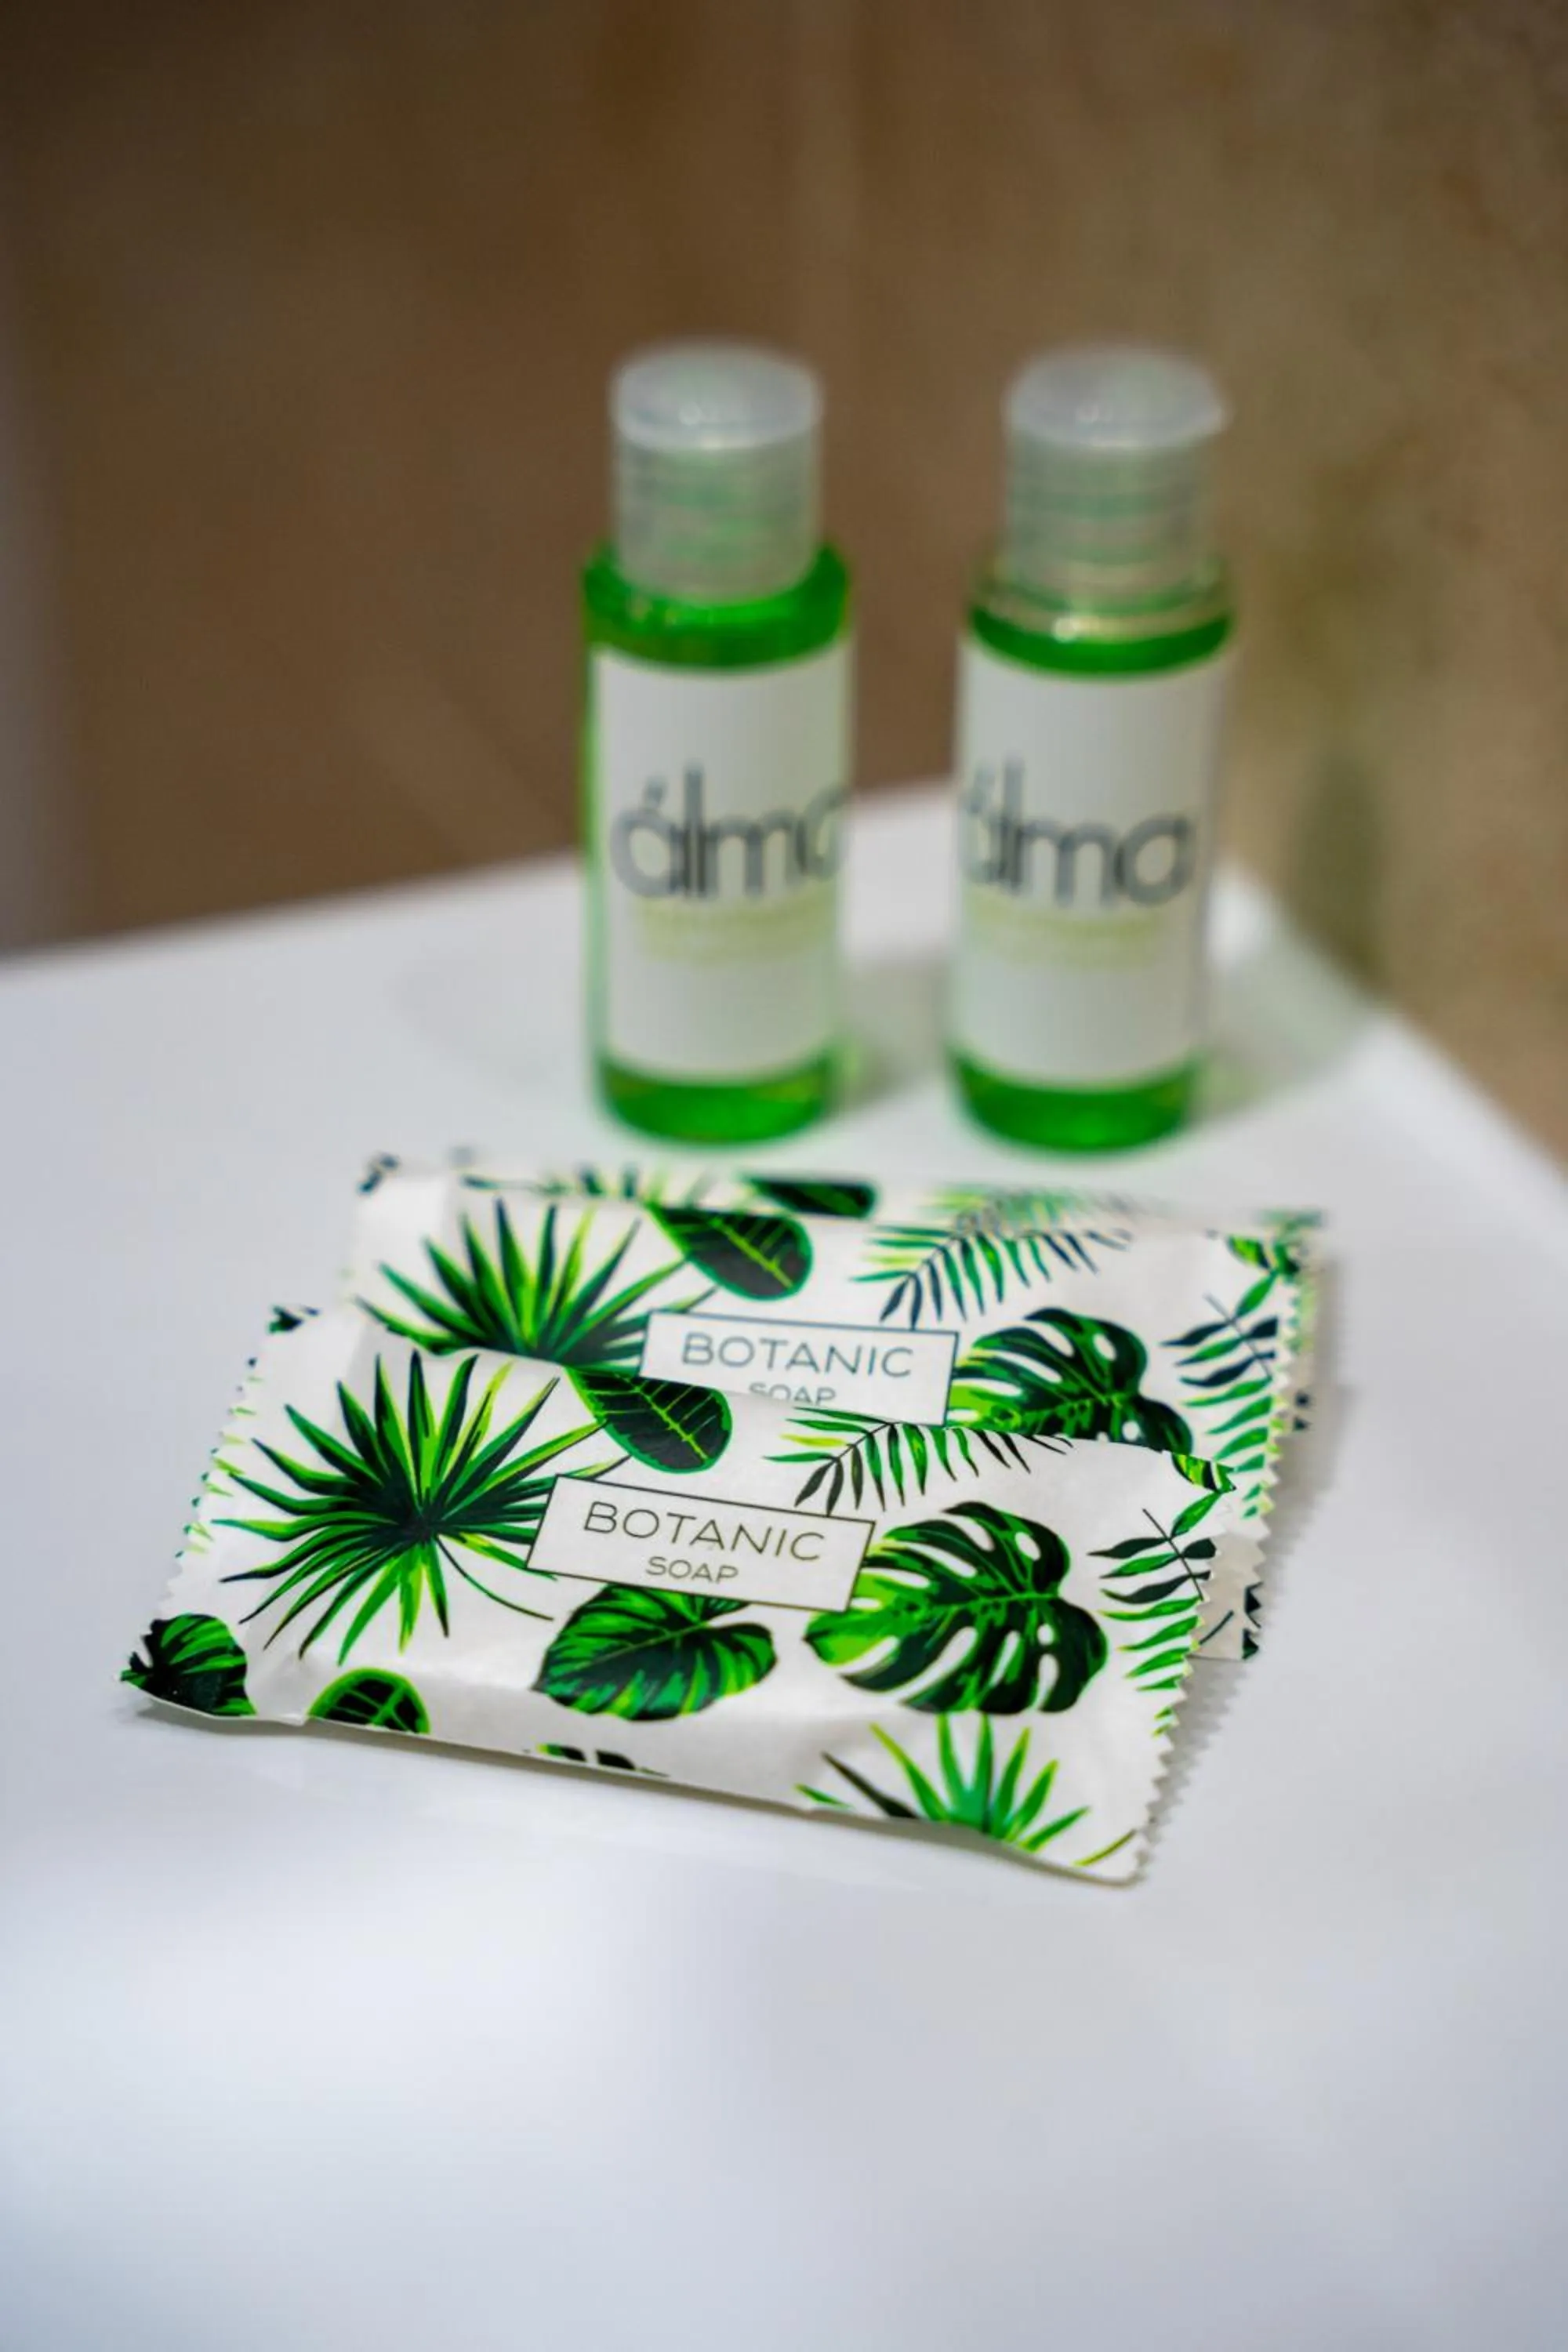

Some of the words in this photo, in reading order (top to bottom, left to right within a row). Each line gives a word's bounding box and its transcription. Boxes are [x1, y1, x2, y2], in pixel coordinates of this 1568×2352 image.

[681, 1331, 913, 1378] BOTANIC
[583, 1501, 824, 1561] BOTANIC
[645, 1556, 739, 1583] SOAP
